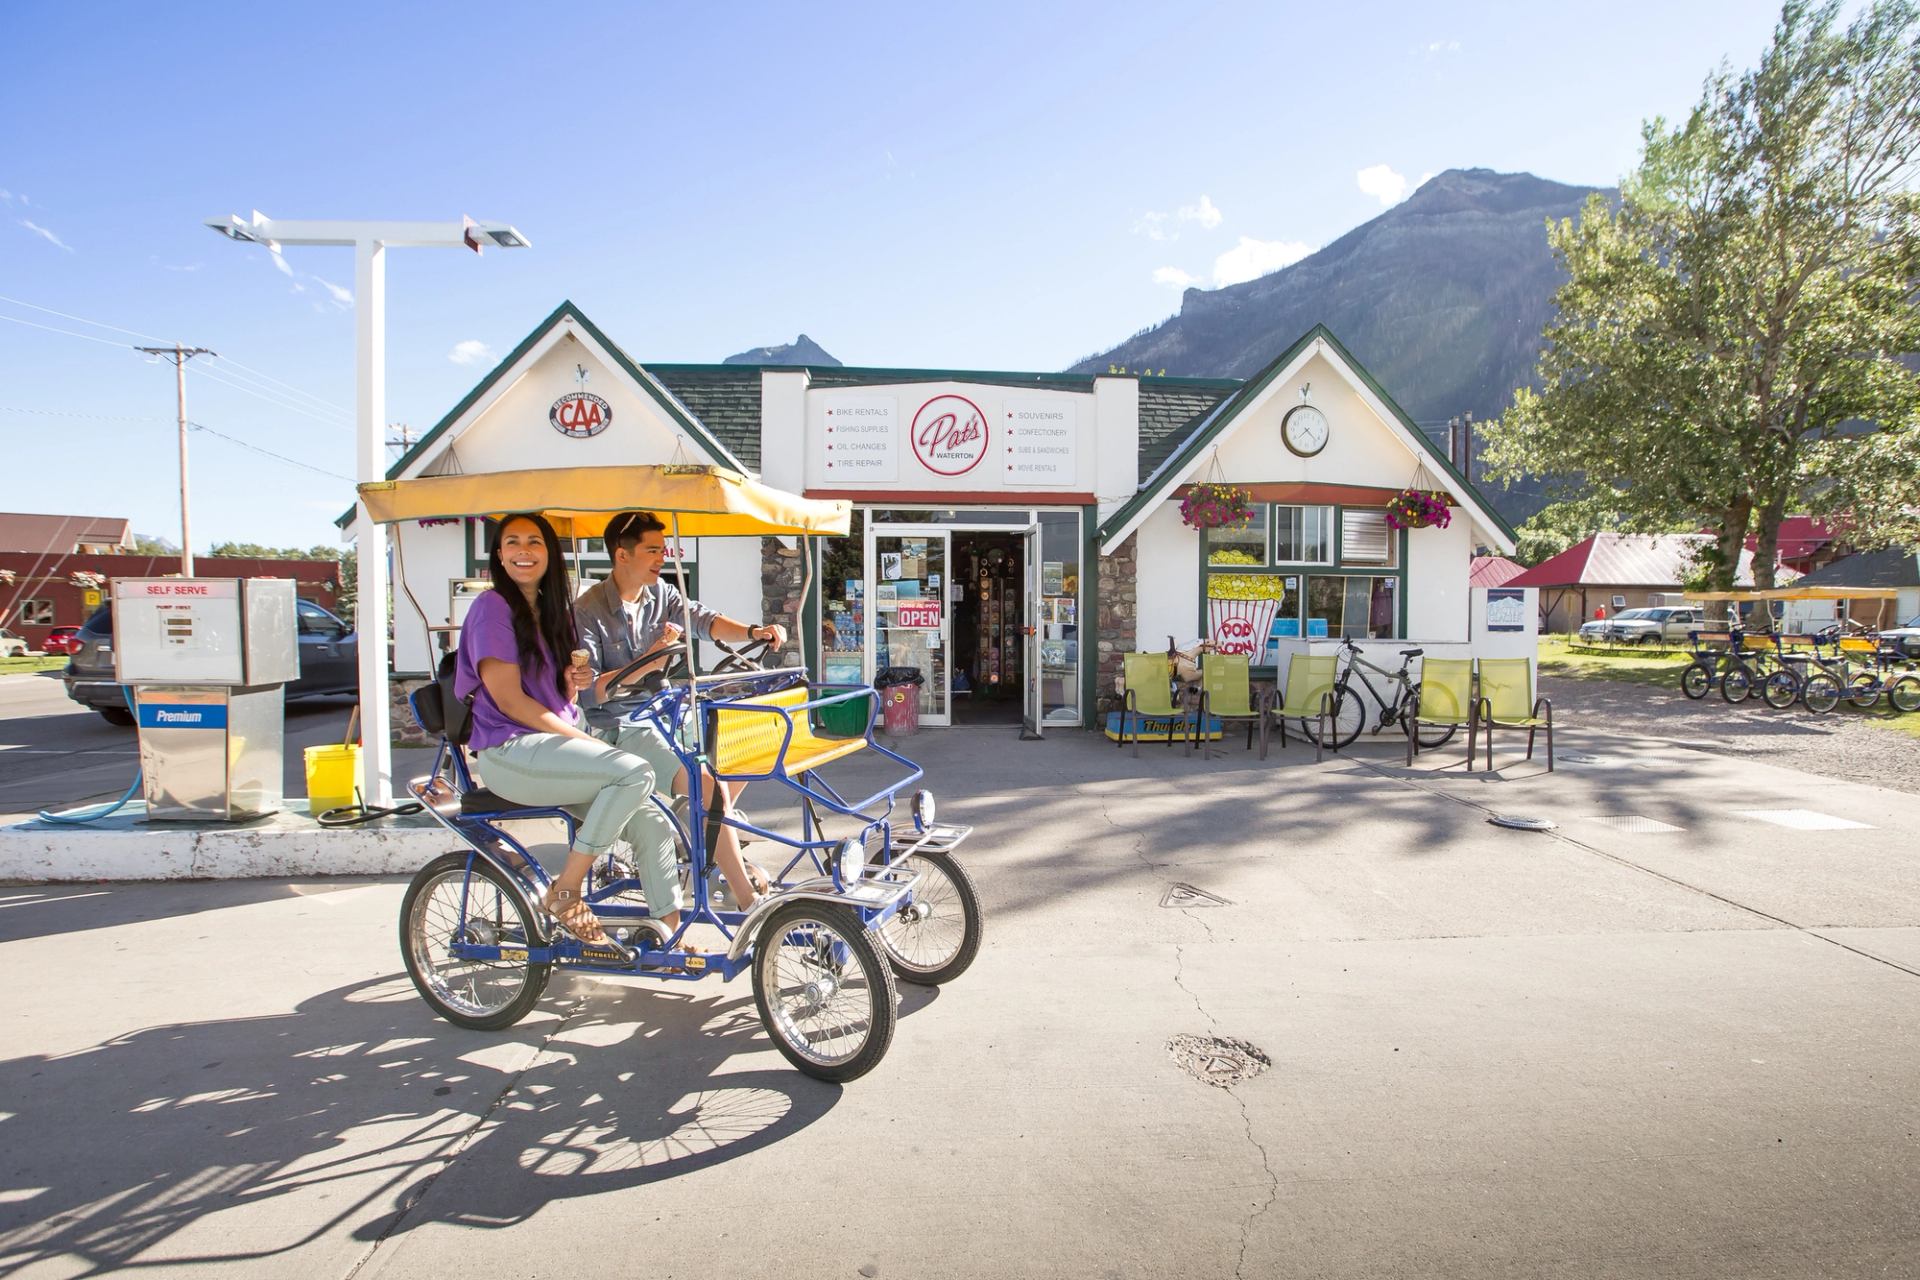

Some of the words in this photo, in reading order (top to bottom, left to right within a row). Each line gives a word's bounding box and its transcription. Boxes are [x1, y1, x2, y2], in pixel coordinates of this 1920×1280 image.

[559, 398, 602, 431] CAA
[836, 408, 853, 416] BIKE
[855, 408, 889, 416] RENTALS
[1018, 412, 1064, 420] SOUVENIRS
[836, 425, 860, 433] FISHING
[860, 425, 889, 433] SUPPLIES
[1018, 428, 1067, 437] CONFECTIONERY
[919, 413, 980, 457] Pat's
[836, 442, 848, 450] OIL
[850, 442, 887, 450] CHANGES
[837, 459, 854, 467] TIRE
[855, 459, 883, 467] REPAIR
[147, 585, 171, 595] SELF
[174, 585, 208, 595] SERVE
[455, 582, 464, 593] 2
[900, 610, 940, 626] OPEN
[1221, 622, 1252, 639] POP
[156, 709, 202, 722] Premium
